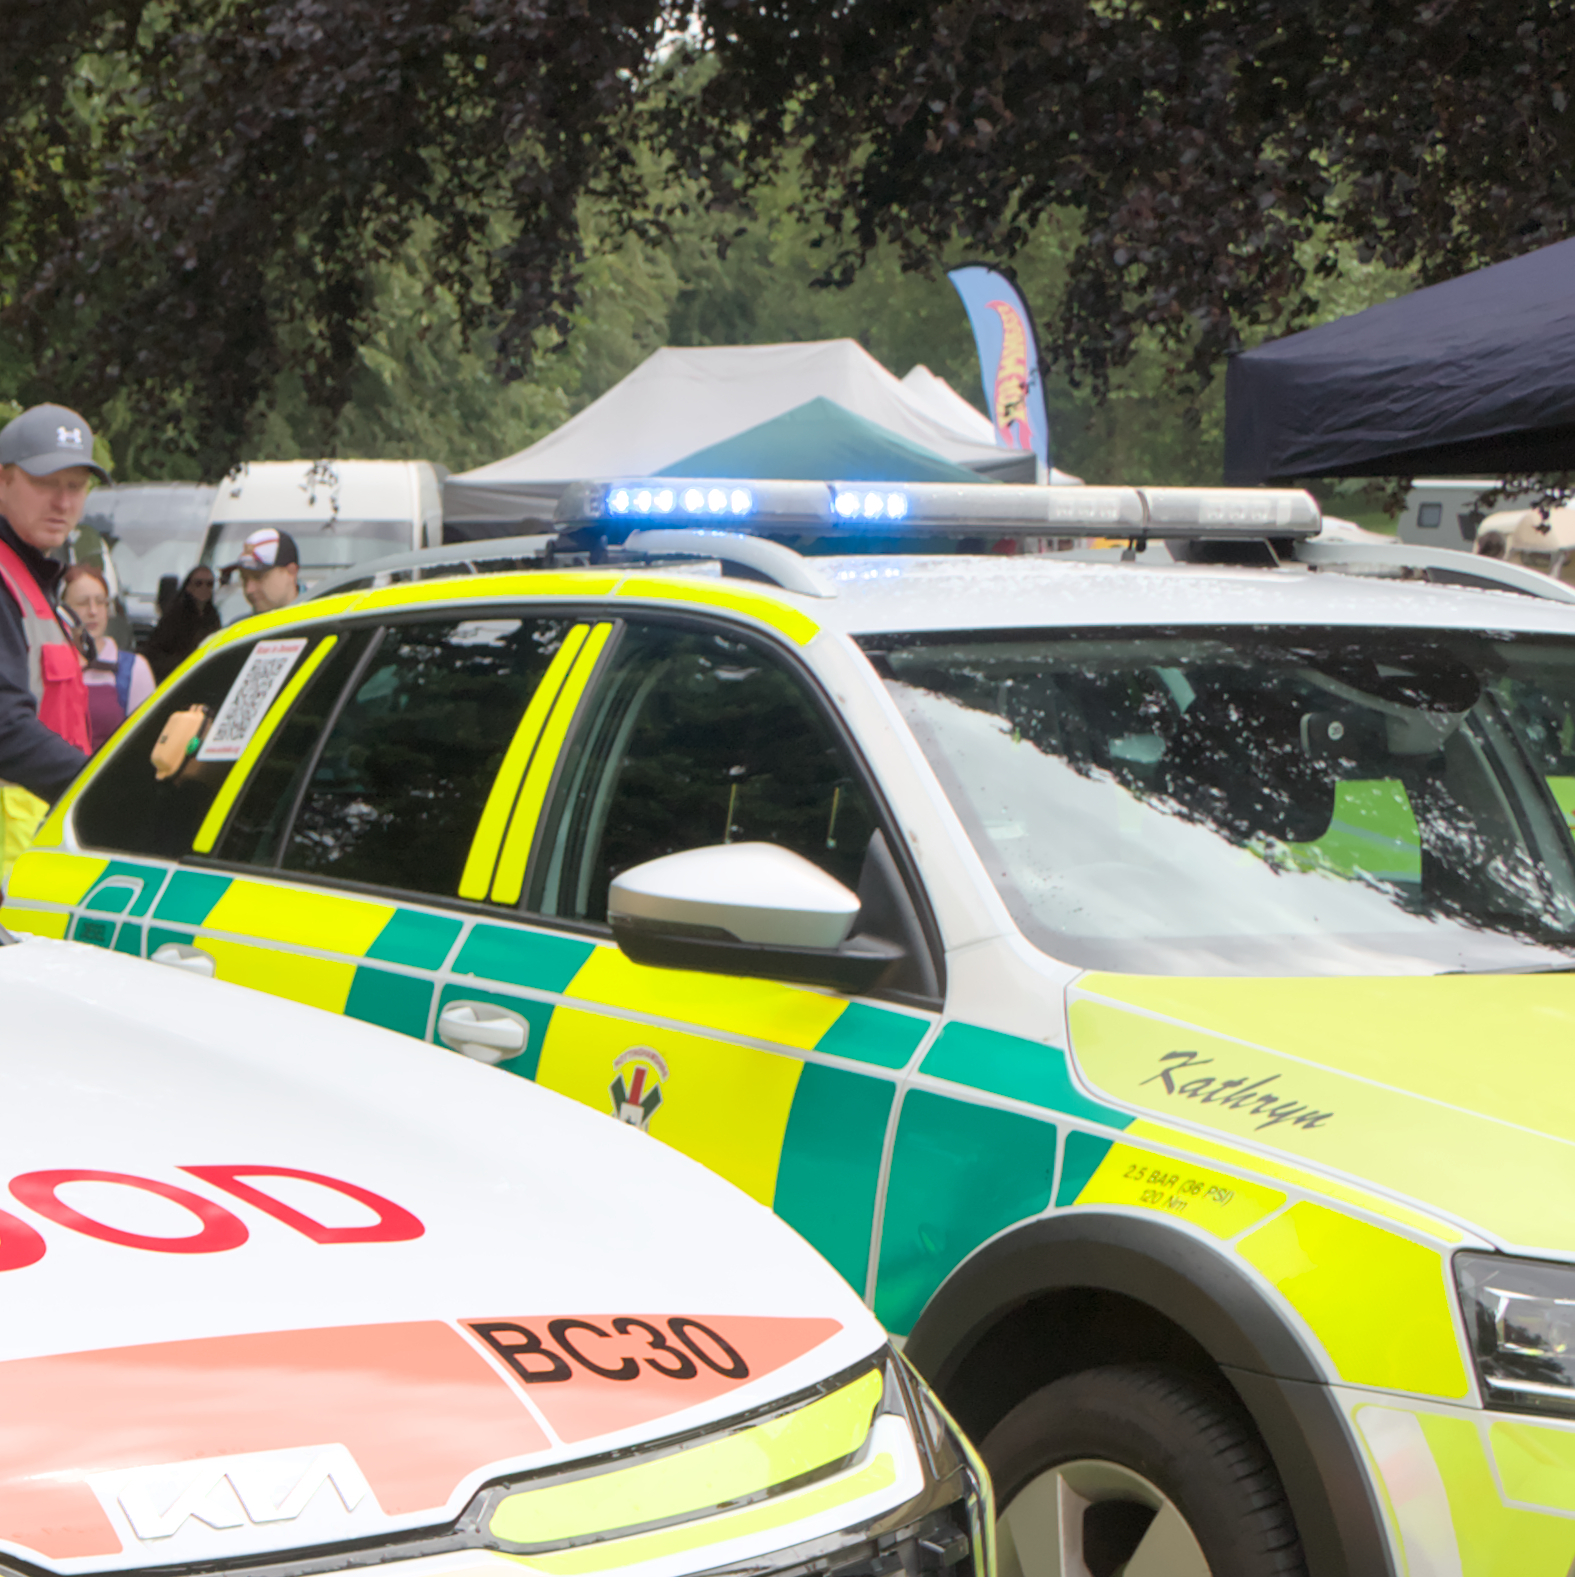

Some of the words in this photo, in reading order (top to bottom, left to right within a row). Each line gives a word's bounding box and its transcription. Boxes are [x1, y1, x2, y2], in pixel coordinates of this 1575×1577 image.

[1139, 1051, 1334, 1132] Kathryn
[1147, 1169, 1179, 1189] BAR
[466, 1317, 751, 1385] BC30
